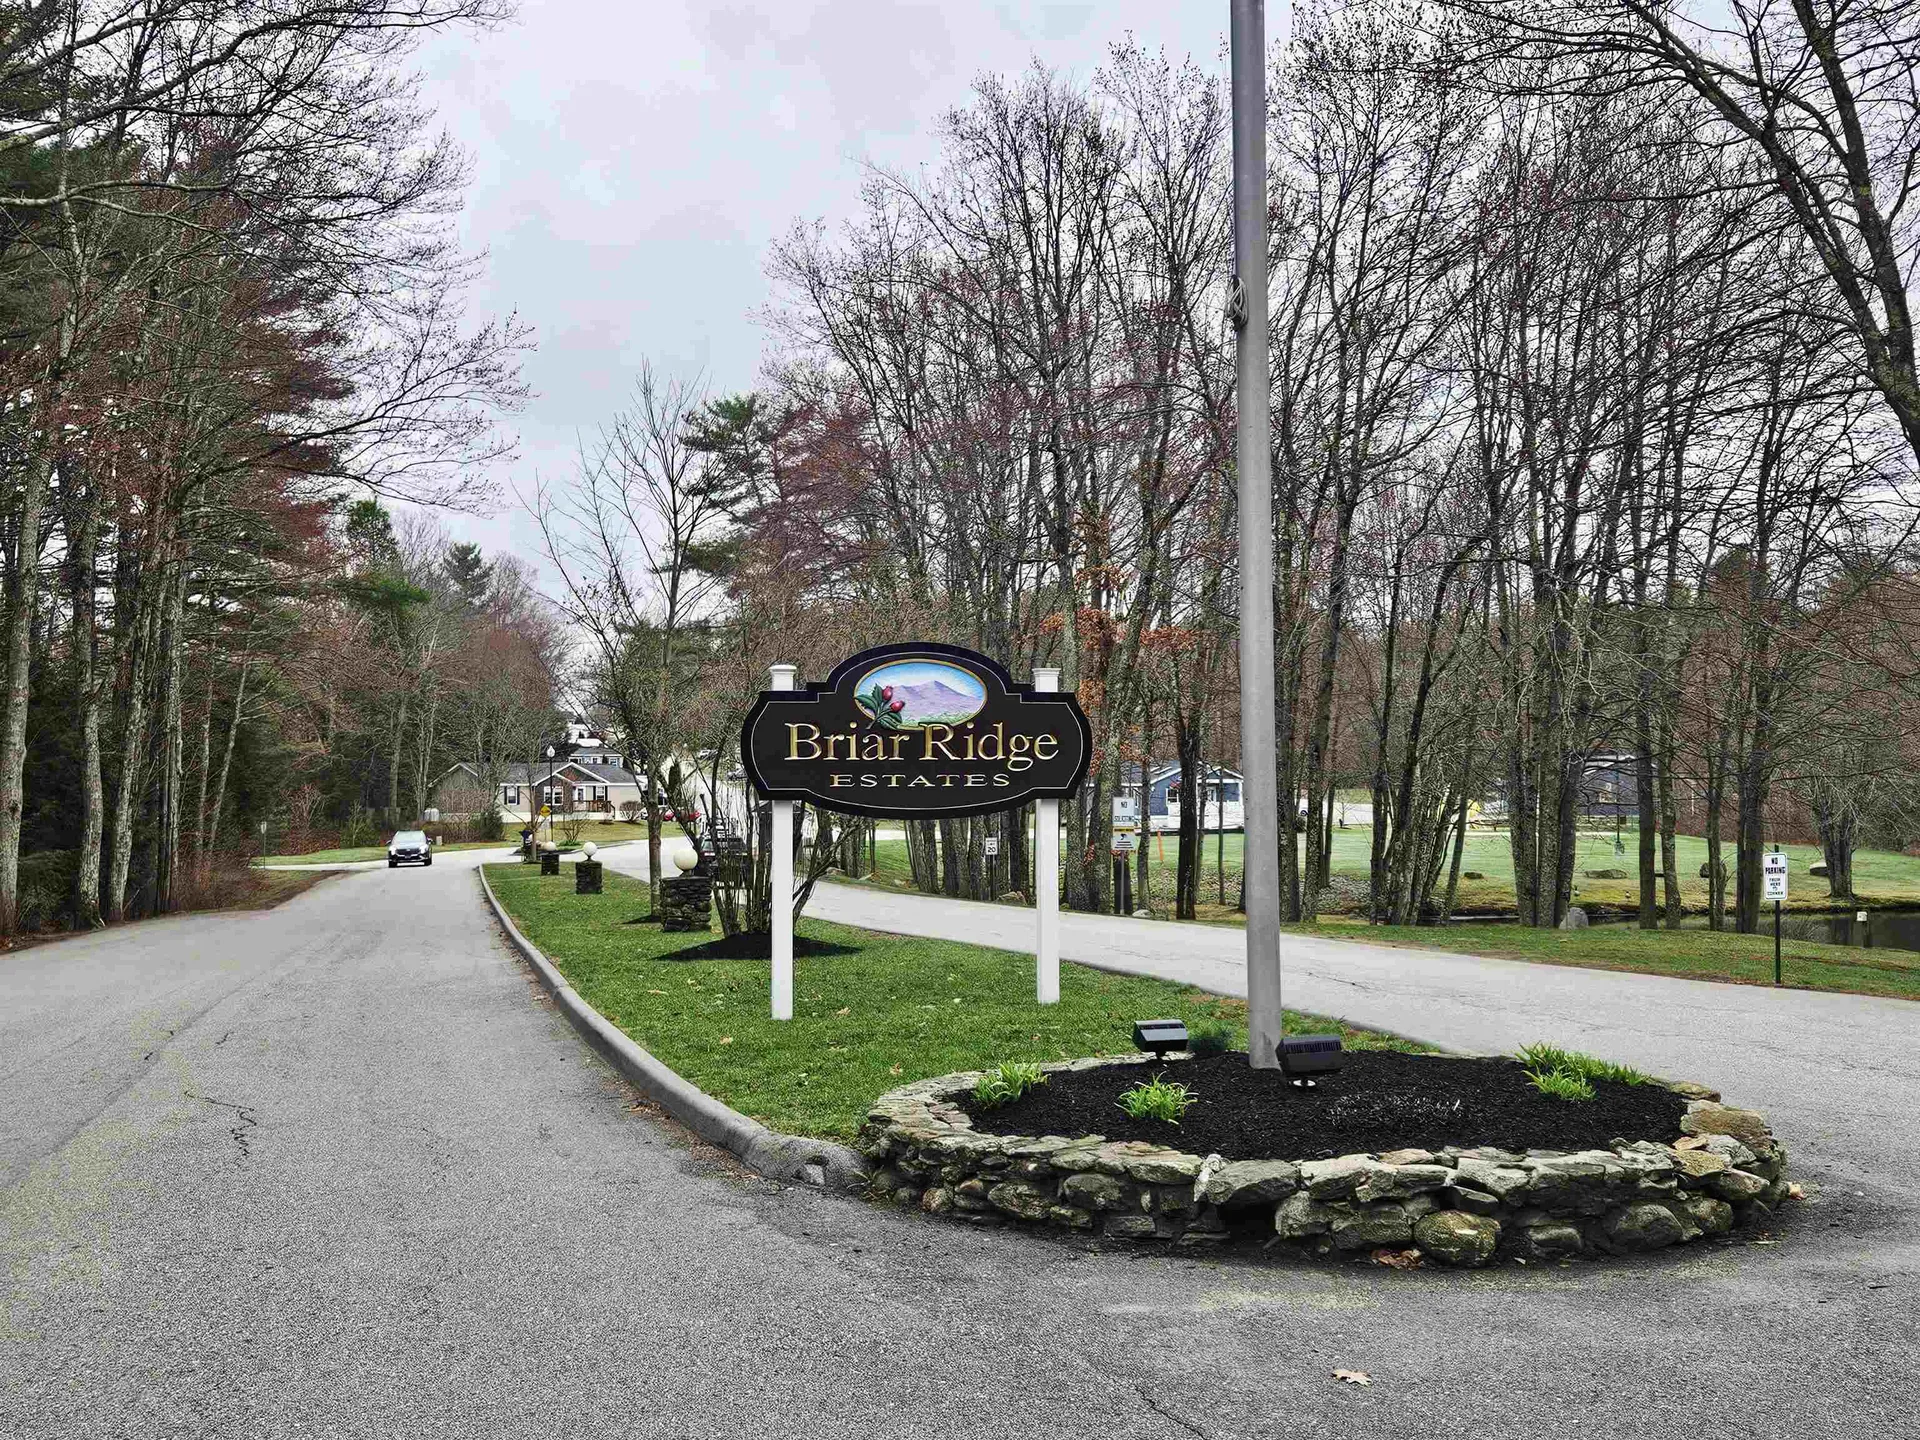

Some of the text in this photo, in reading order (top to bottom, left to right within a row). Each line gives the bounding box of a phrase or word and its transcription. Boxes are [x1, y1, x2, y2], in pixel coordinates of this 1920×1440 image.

[783, 721, 1060, 772] Briar Ridge
[829, 773, 1010, 788] ESTATES
[1120, 801, 1128, 809] NO
[1771, 857, 1778, 865] NO
[1765, 866, 1786, 874] PARKING
